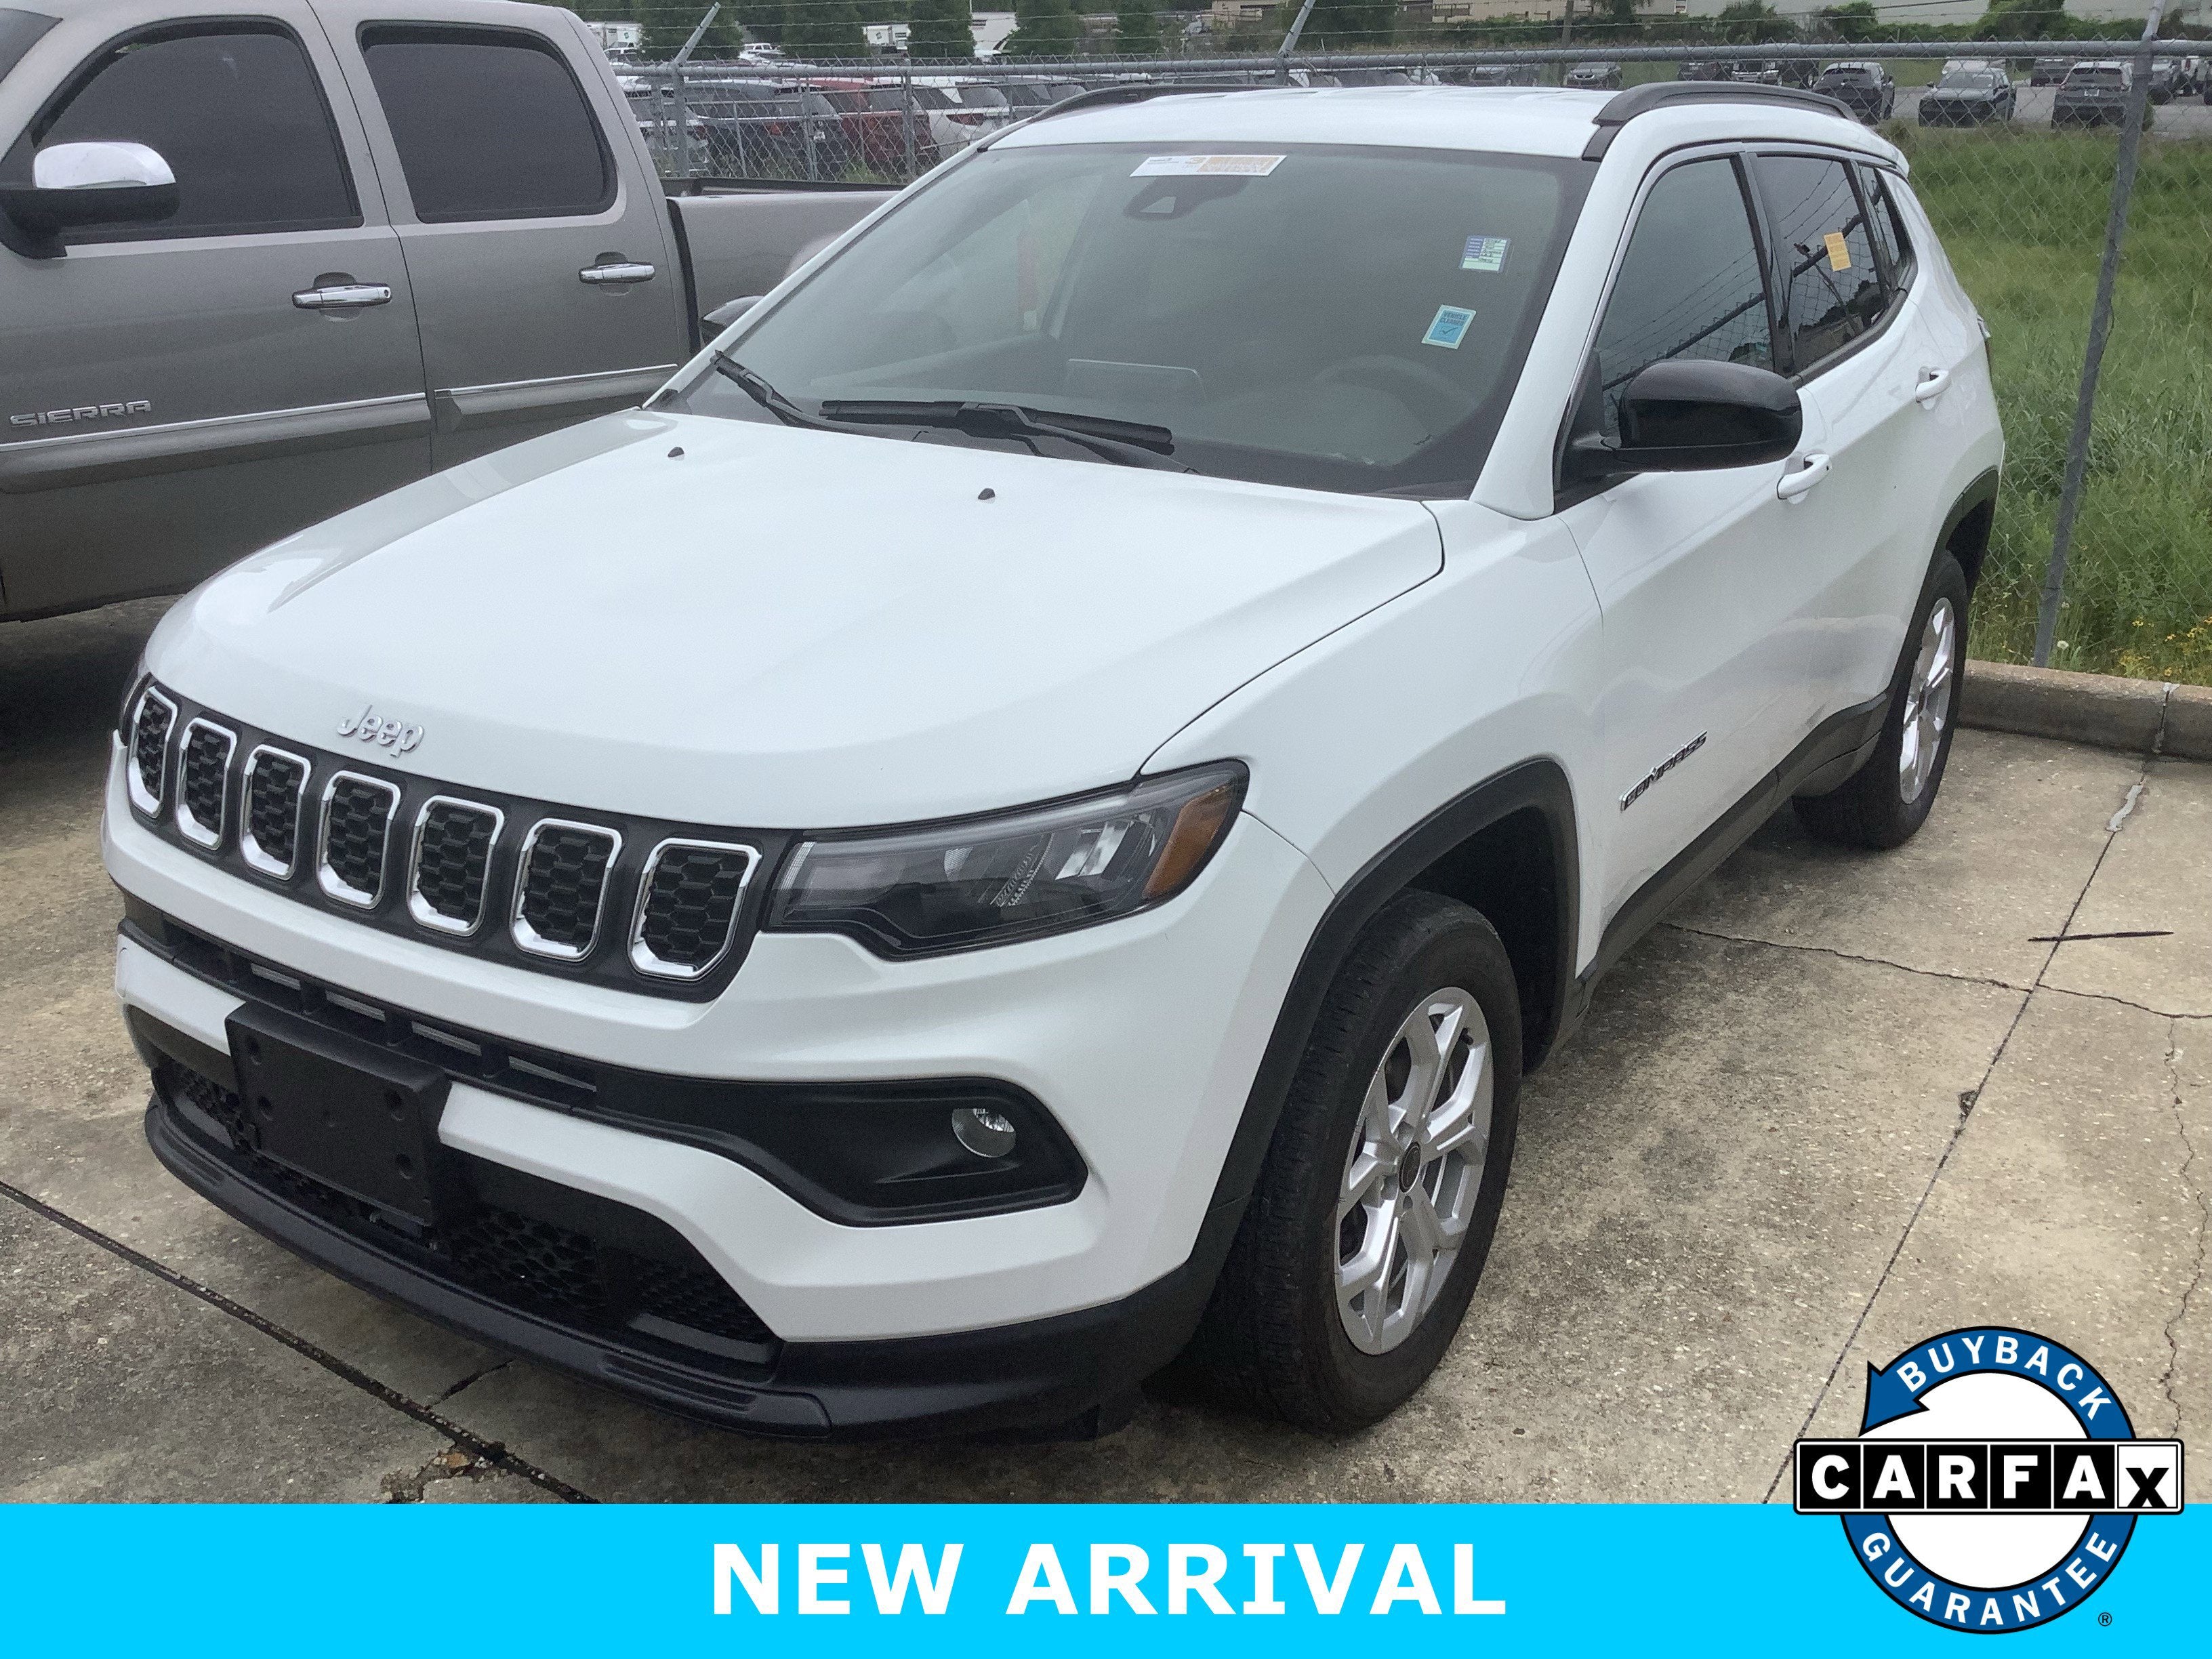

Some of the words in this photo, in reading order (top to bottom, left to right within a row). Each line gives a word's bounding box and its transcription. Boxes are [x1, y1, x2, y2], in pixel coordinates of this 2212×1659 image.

[1439, 317, 1465, 326] CLEANED
[1443, 311, 1467, 321] VEHICLE
[10, 400, 152, 428] SIERRA
[337, 704, 425, 758] Jeep
[1619, 730, 1708, 813] COMPASS
